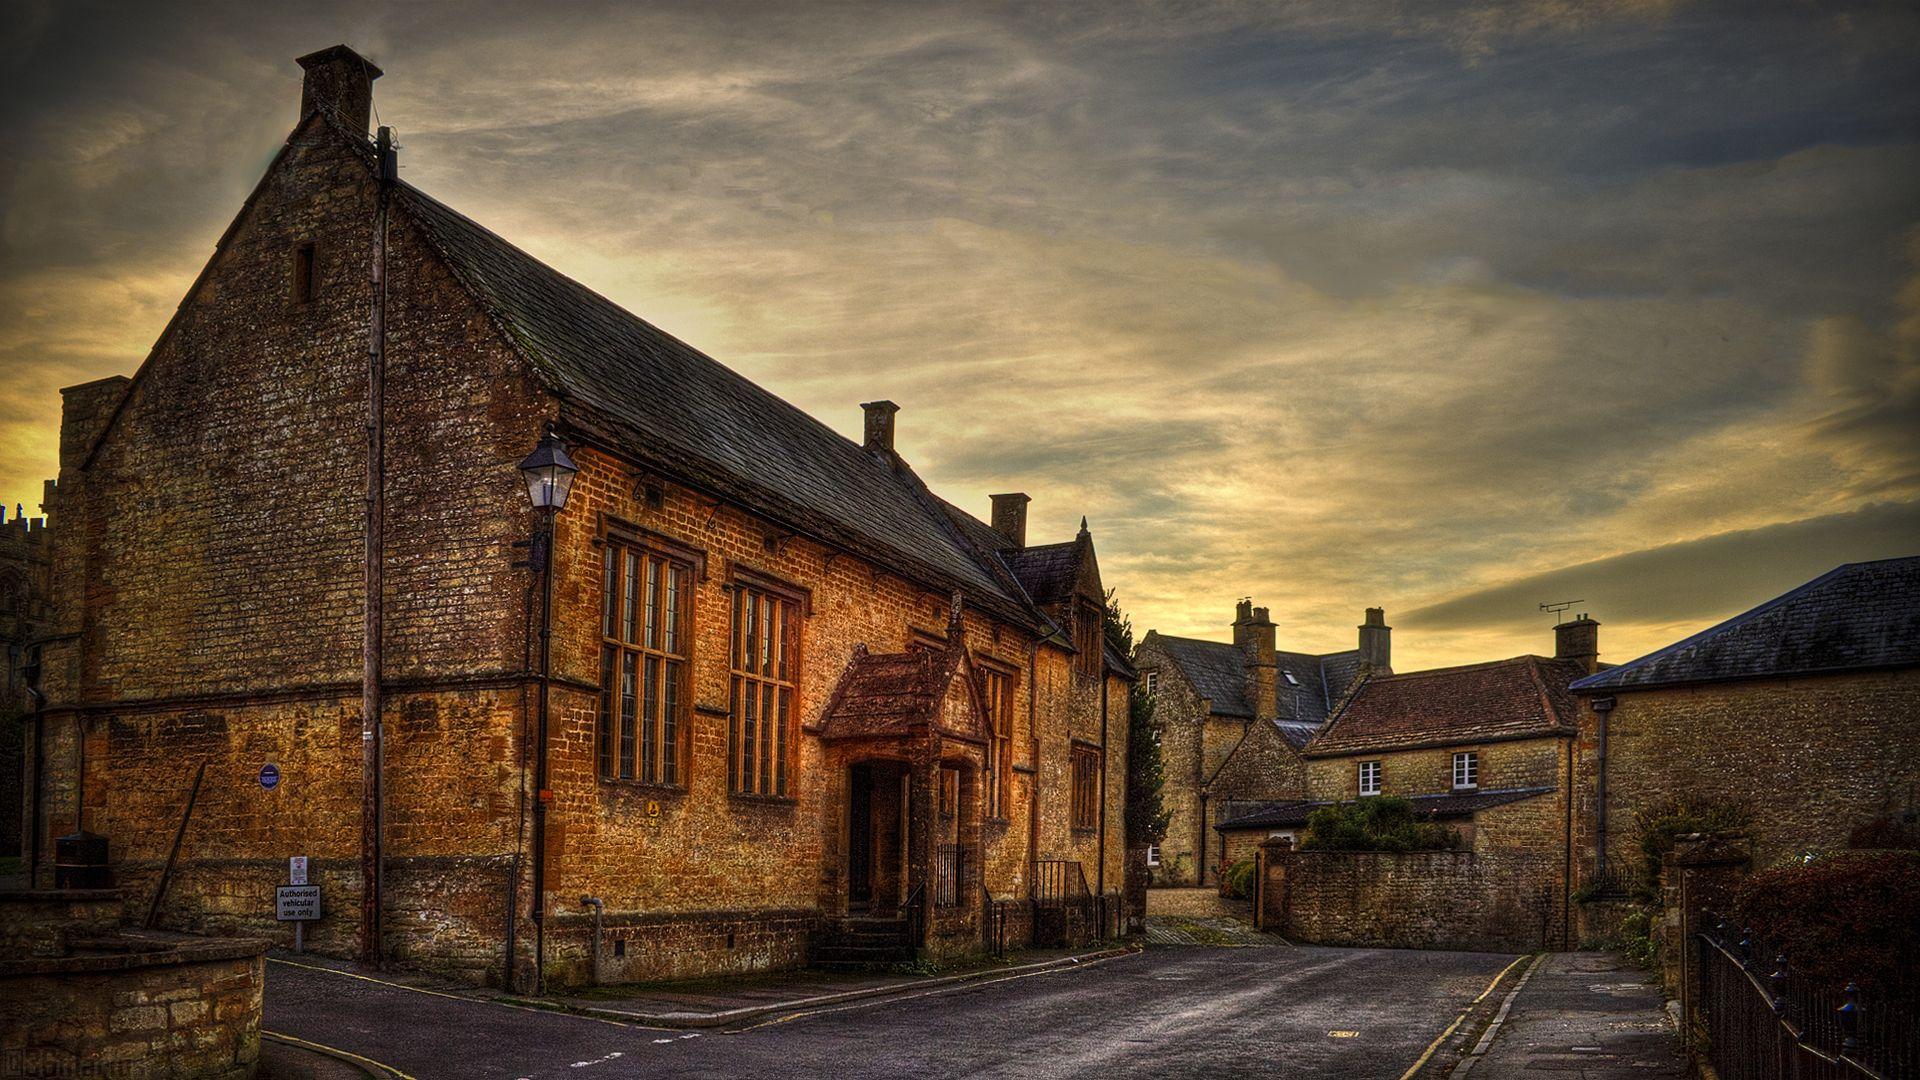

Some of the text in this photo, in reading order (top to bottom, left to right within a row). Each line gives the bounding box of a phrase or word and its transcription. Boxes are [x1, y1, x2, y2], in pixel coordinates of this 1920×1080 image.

[279, 889, 318, 898] Authorised
[282, 899, 314, 907] vehicular
[297, 908, 314, 917] only
